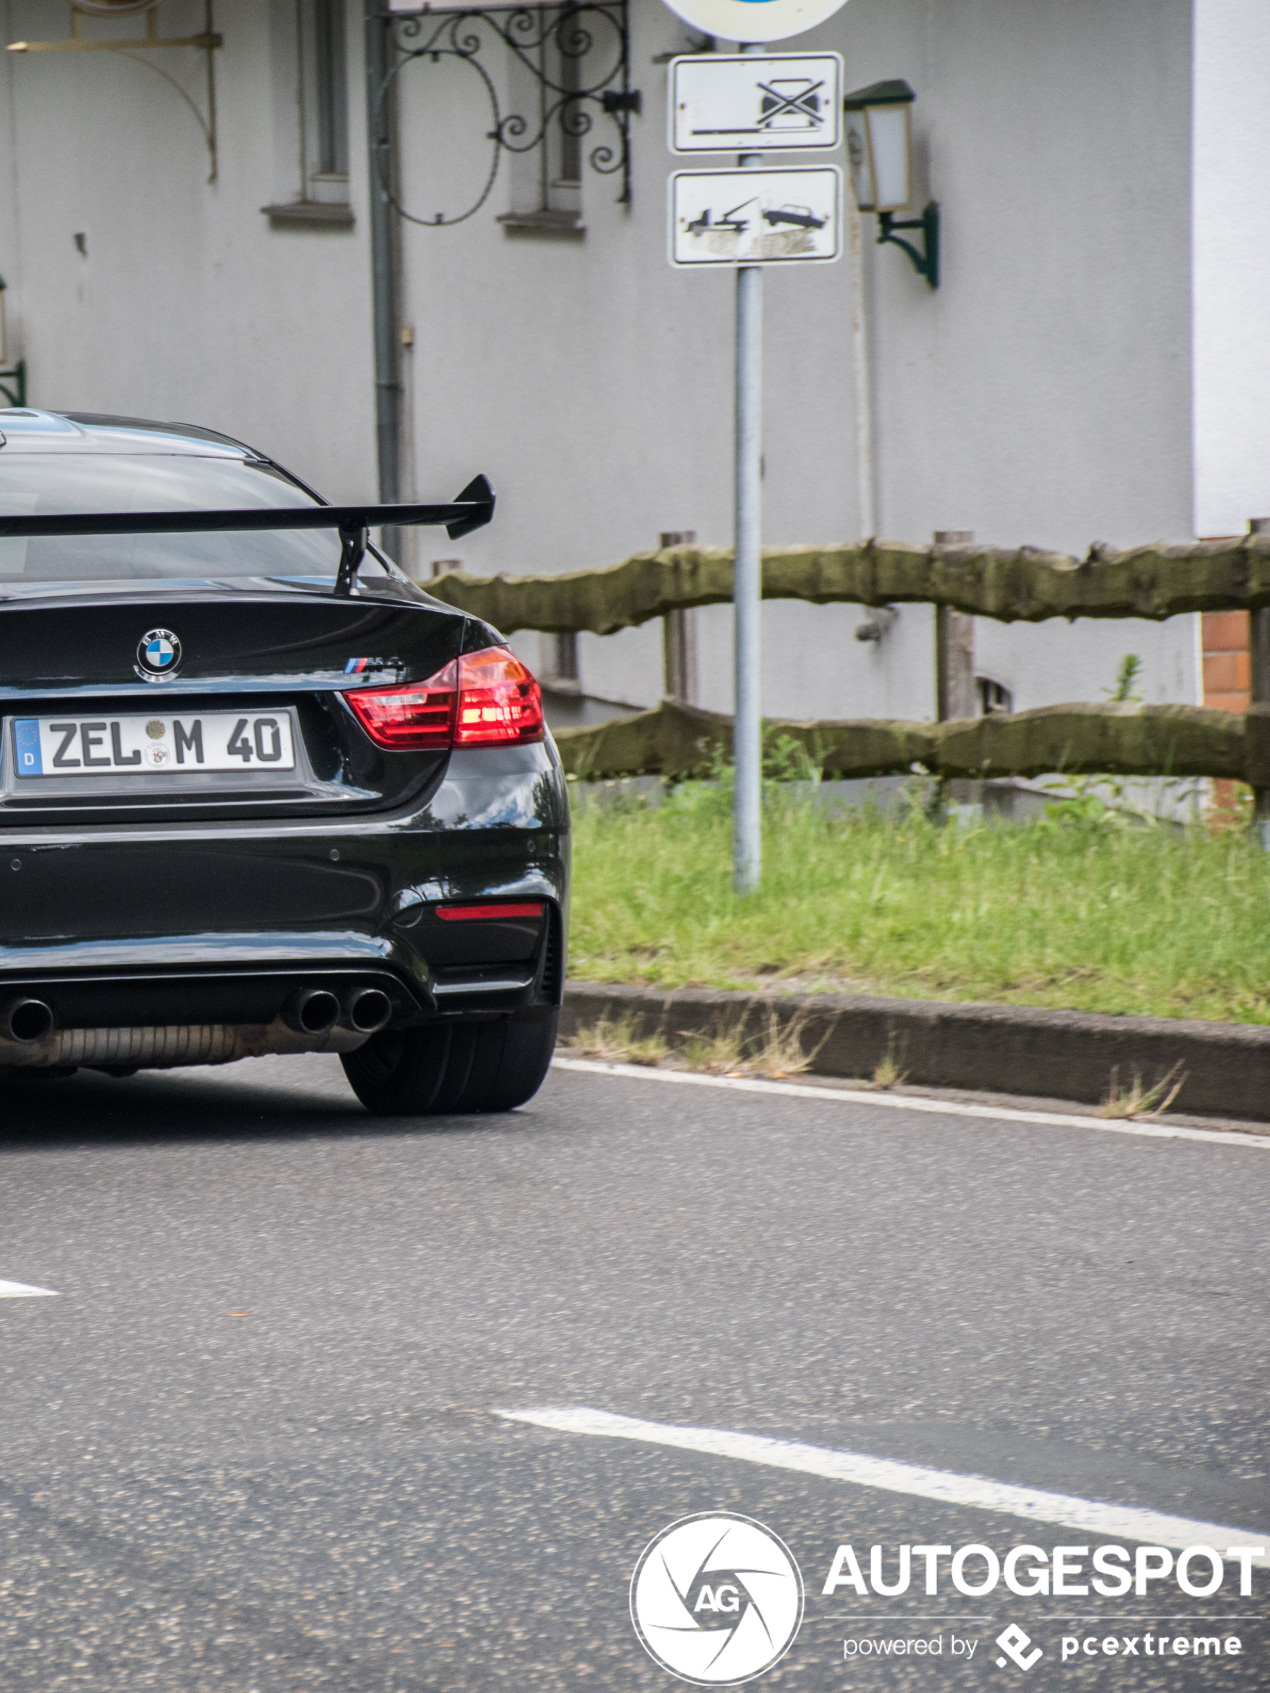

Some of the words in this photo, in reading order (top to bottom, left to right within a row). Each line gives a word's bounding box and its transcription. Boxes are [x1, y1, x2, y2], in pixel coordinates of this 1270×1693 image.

[142, 631, 179, 646] BMW
[24, 753, 34, 766] D
[50, 721, 142, 767] ZEL
[173, 719, 205, 764] M
[227, 718, 282, 762] 40
